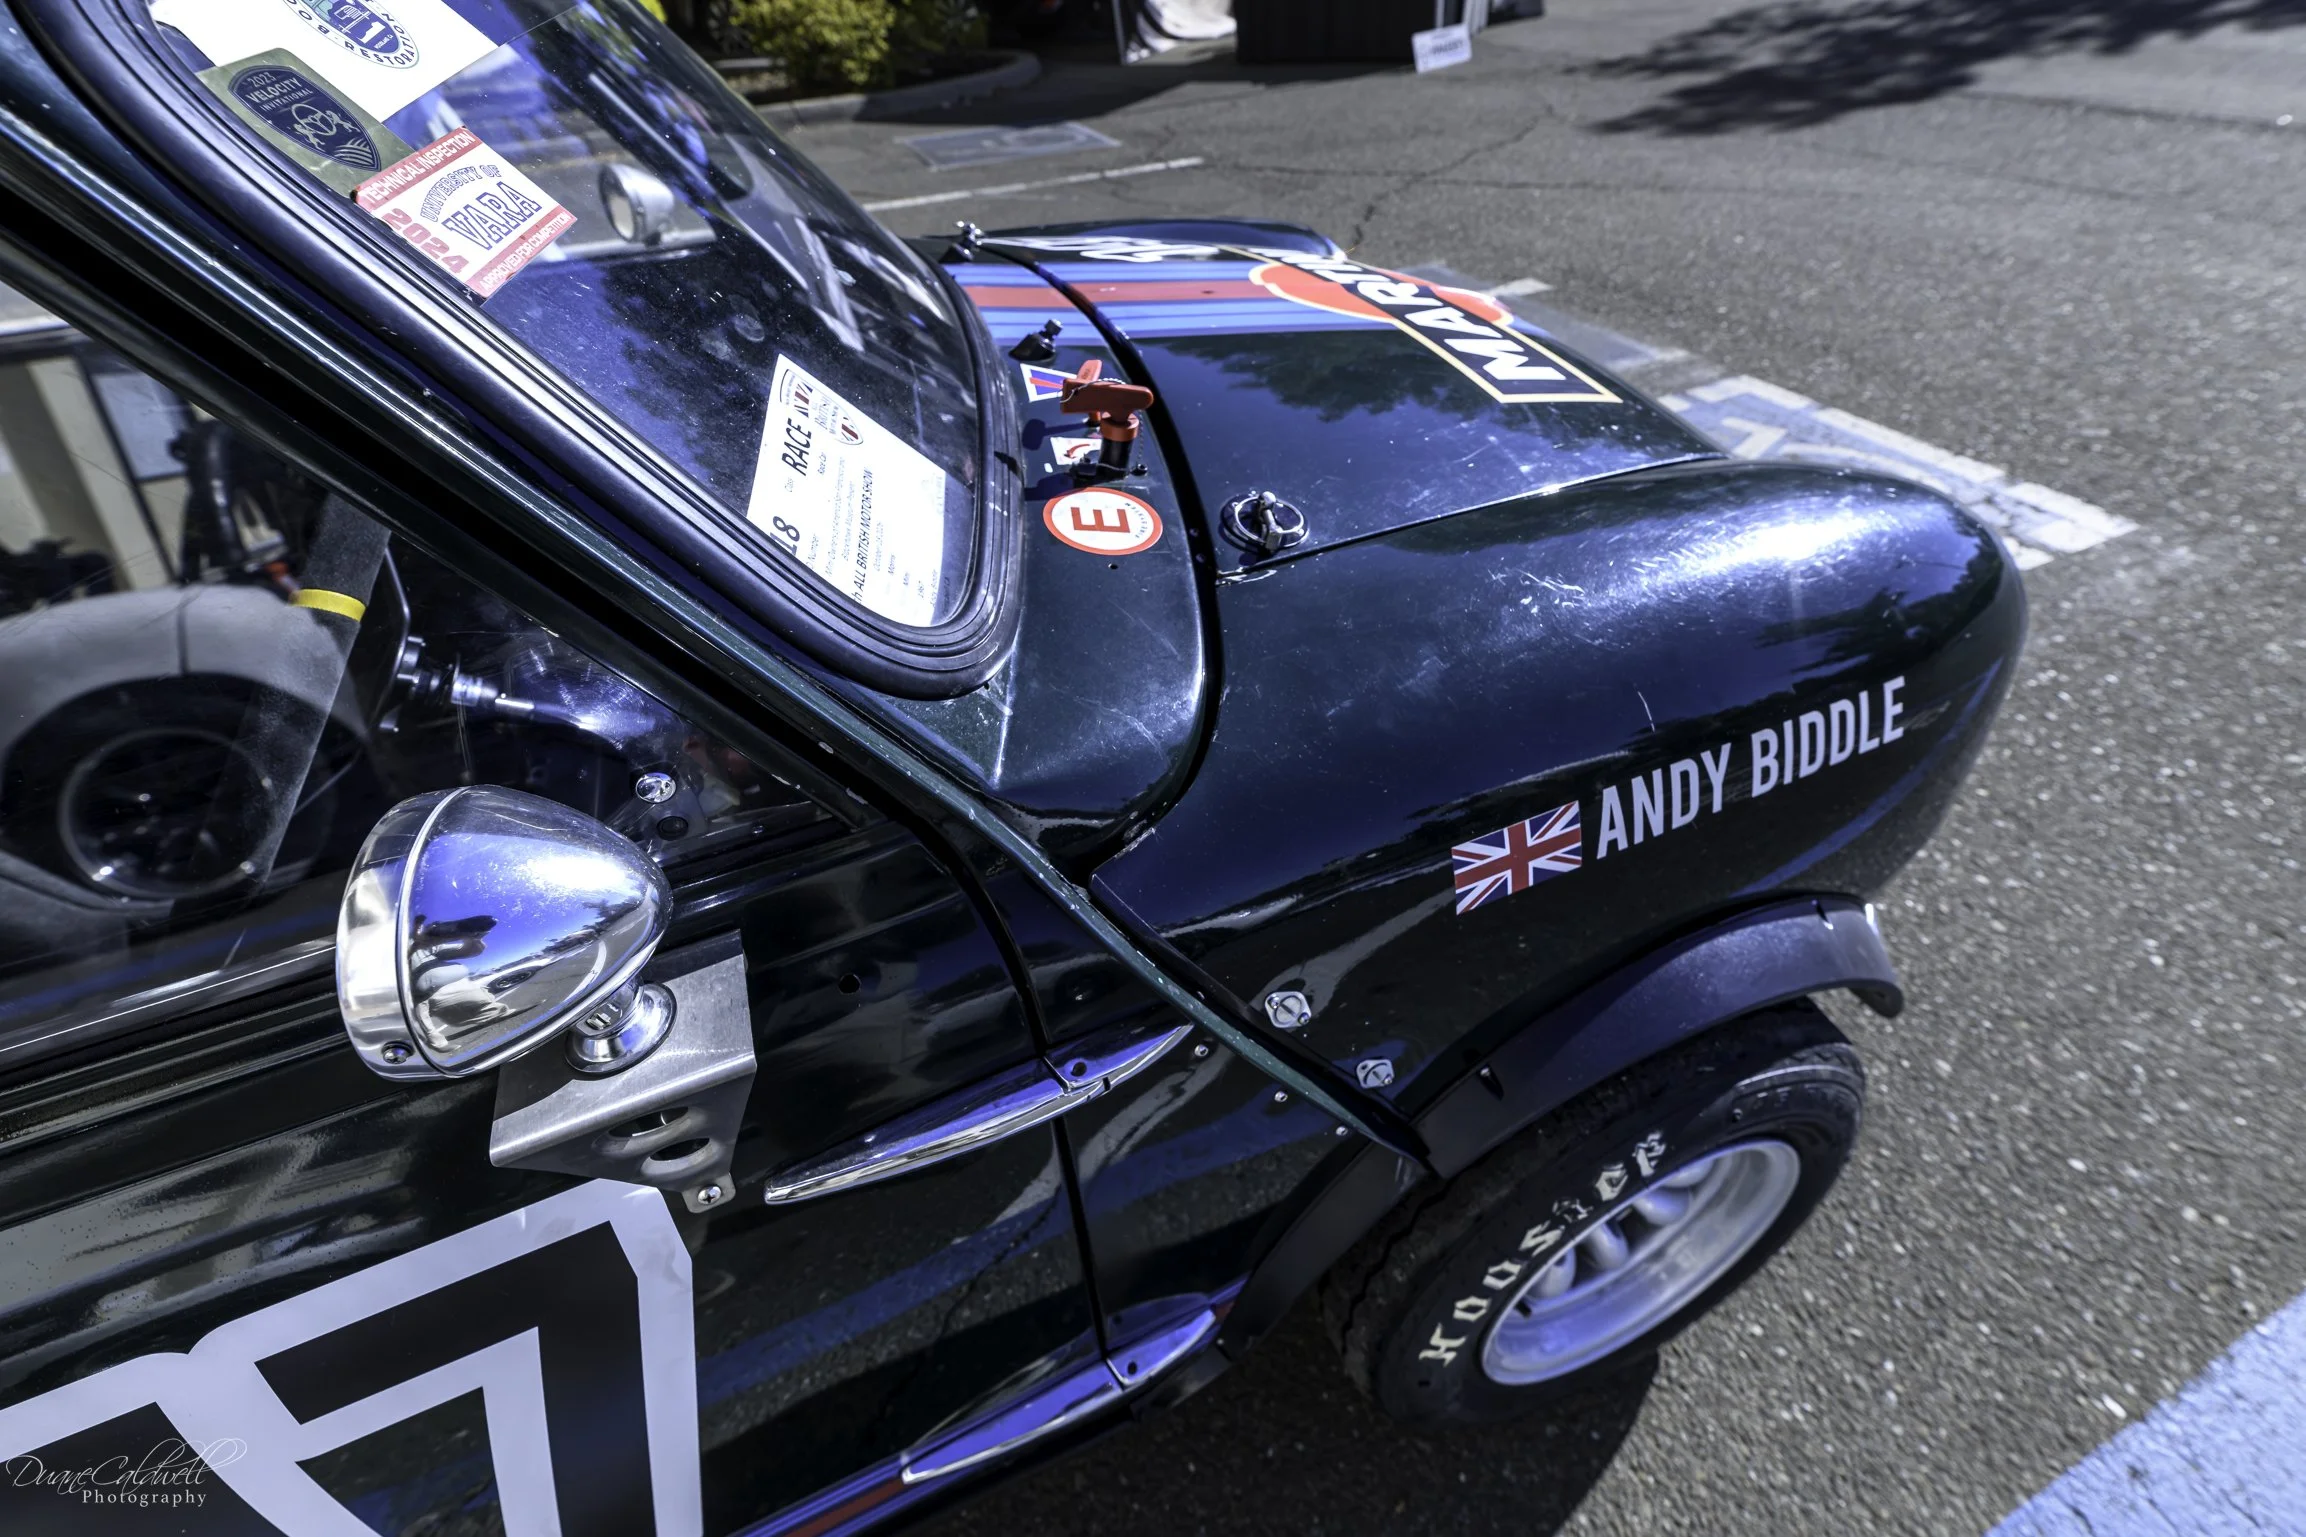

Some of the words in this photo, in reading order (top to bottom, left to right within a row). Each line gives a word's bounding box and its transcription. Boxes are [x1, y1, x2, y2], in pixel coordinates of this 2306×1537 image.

[344, 13, 416, 66] RESTORATION
[245, 77, 302, 103] VELOCITY
[248, 72, 276, 88] 2023
[260, 88, 313, 111] INVITATIONAL
[359, 163, 423, 204] TECHNICAL
[416, 131, 476, 172] INSPECTION
[420, 166, 483, 223] UNIVERSITY
[479, 164, 502, 179] OF
[441, 181, 542, 250] VARA
[381, 207, 470, 273] 2024
[479, 251, 525, 292] APPROVED
[518, 239, 536, 261] FOR
[529, 212, 572, 250] COMPETITION
[782, 418, 811, 476] RACE
[862, 469, 873, 495] SHOW
[860, 494, 872, 530] MOTOR
[1070, 506, 1131, 534] E
[856, 528, 870, 569] BRITISH
[853, 569, 866, 591] ALL
[1596, 742, 1732, 860] ANDY
[1751, 675, 1905, 798] BIDDLE
